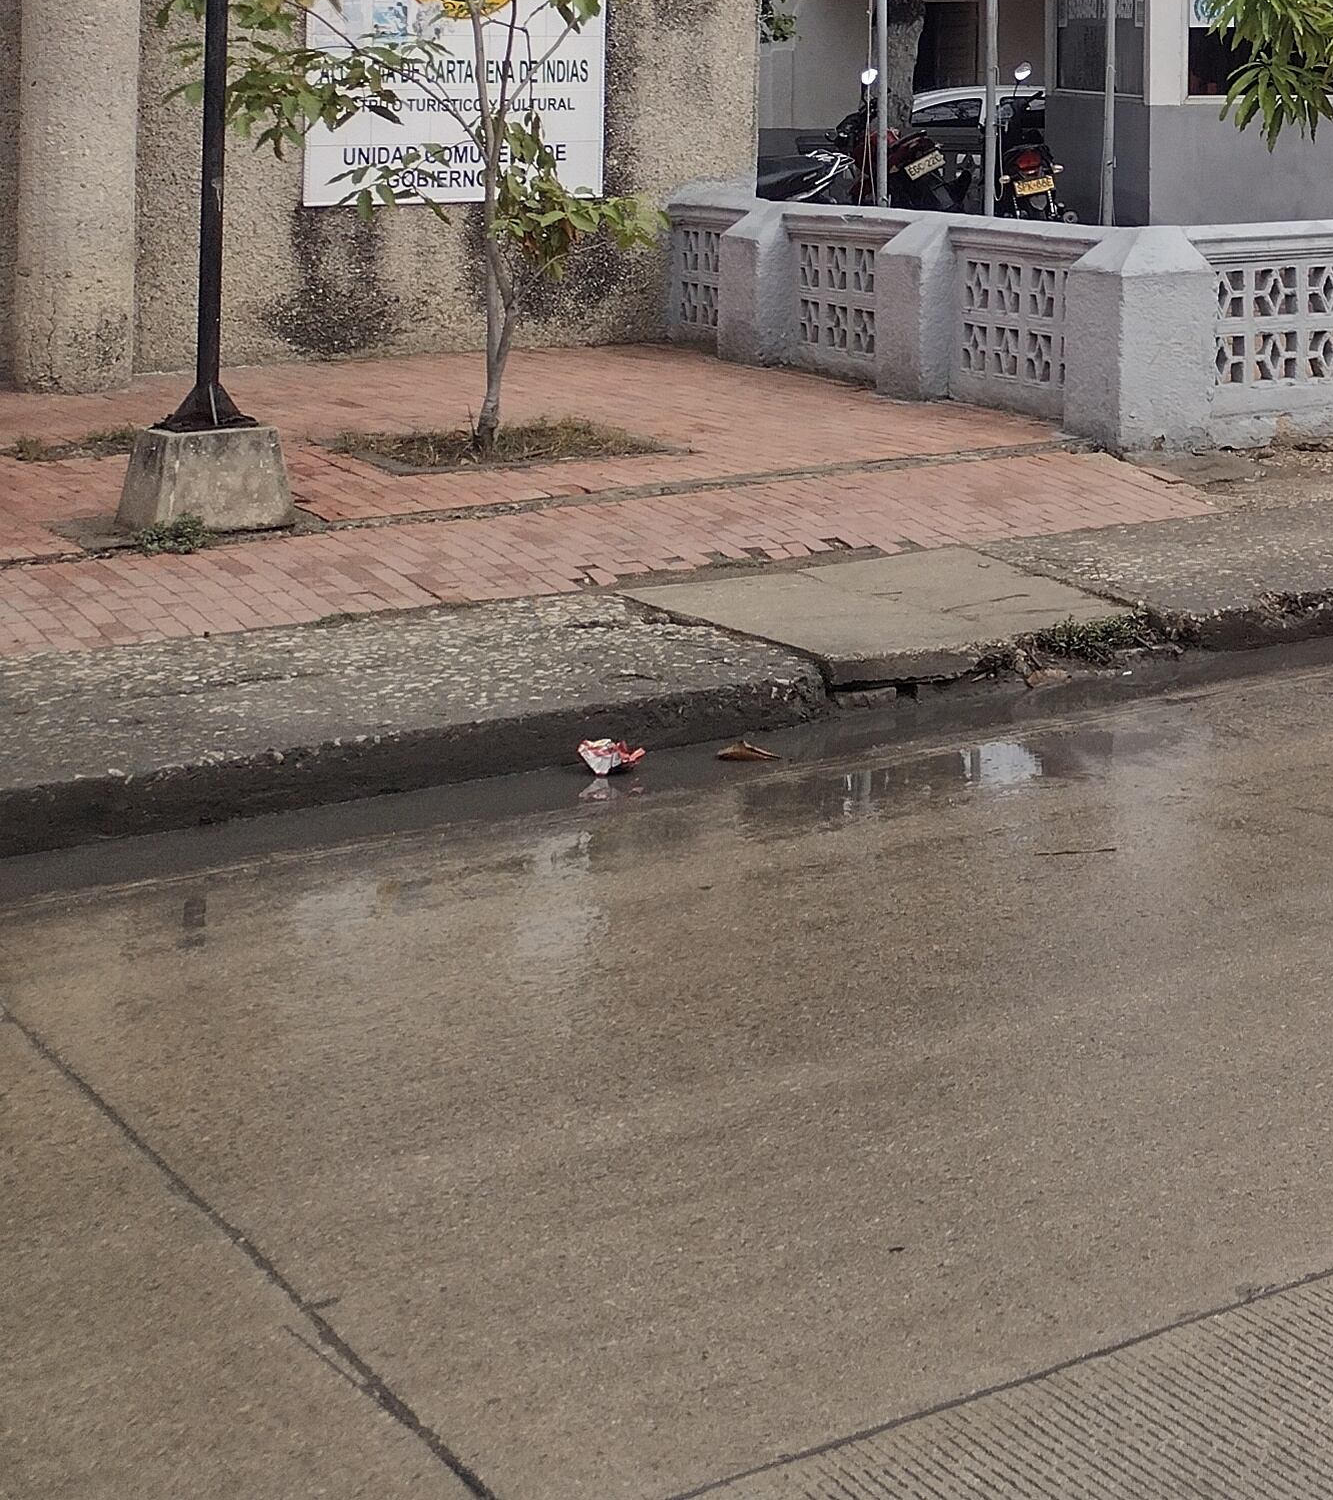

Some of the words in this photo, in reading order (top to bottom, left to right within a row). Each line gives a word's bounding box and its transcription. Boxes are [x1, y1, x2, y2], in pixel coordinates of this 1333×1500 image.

[426, 59, 515, 84] CARTAENA
[520, 60, 538, 83] DE
[543, 59, 589, 83] INDIAS
[407, 98, 482, 112] TURISTICO
